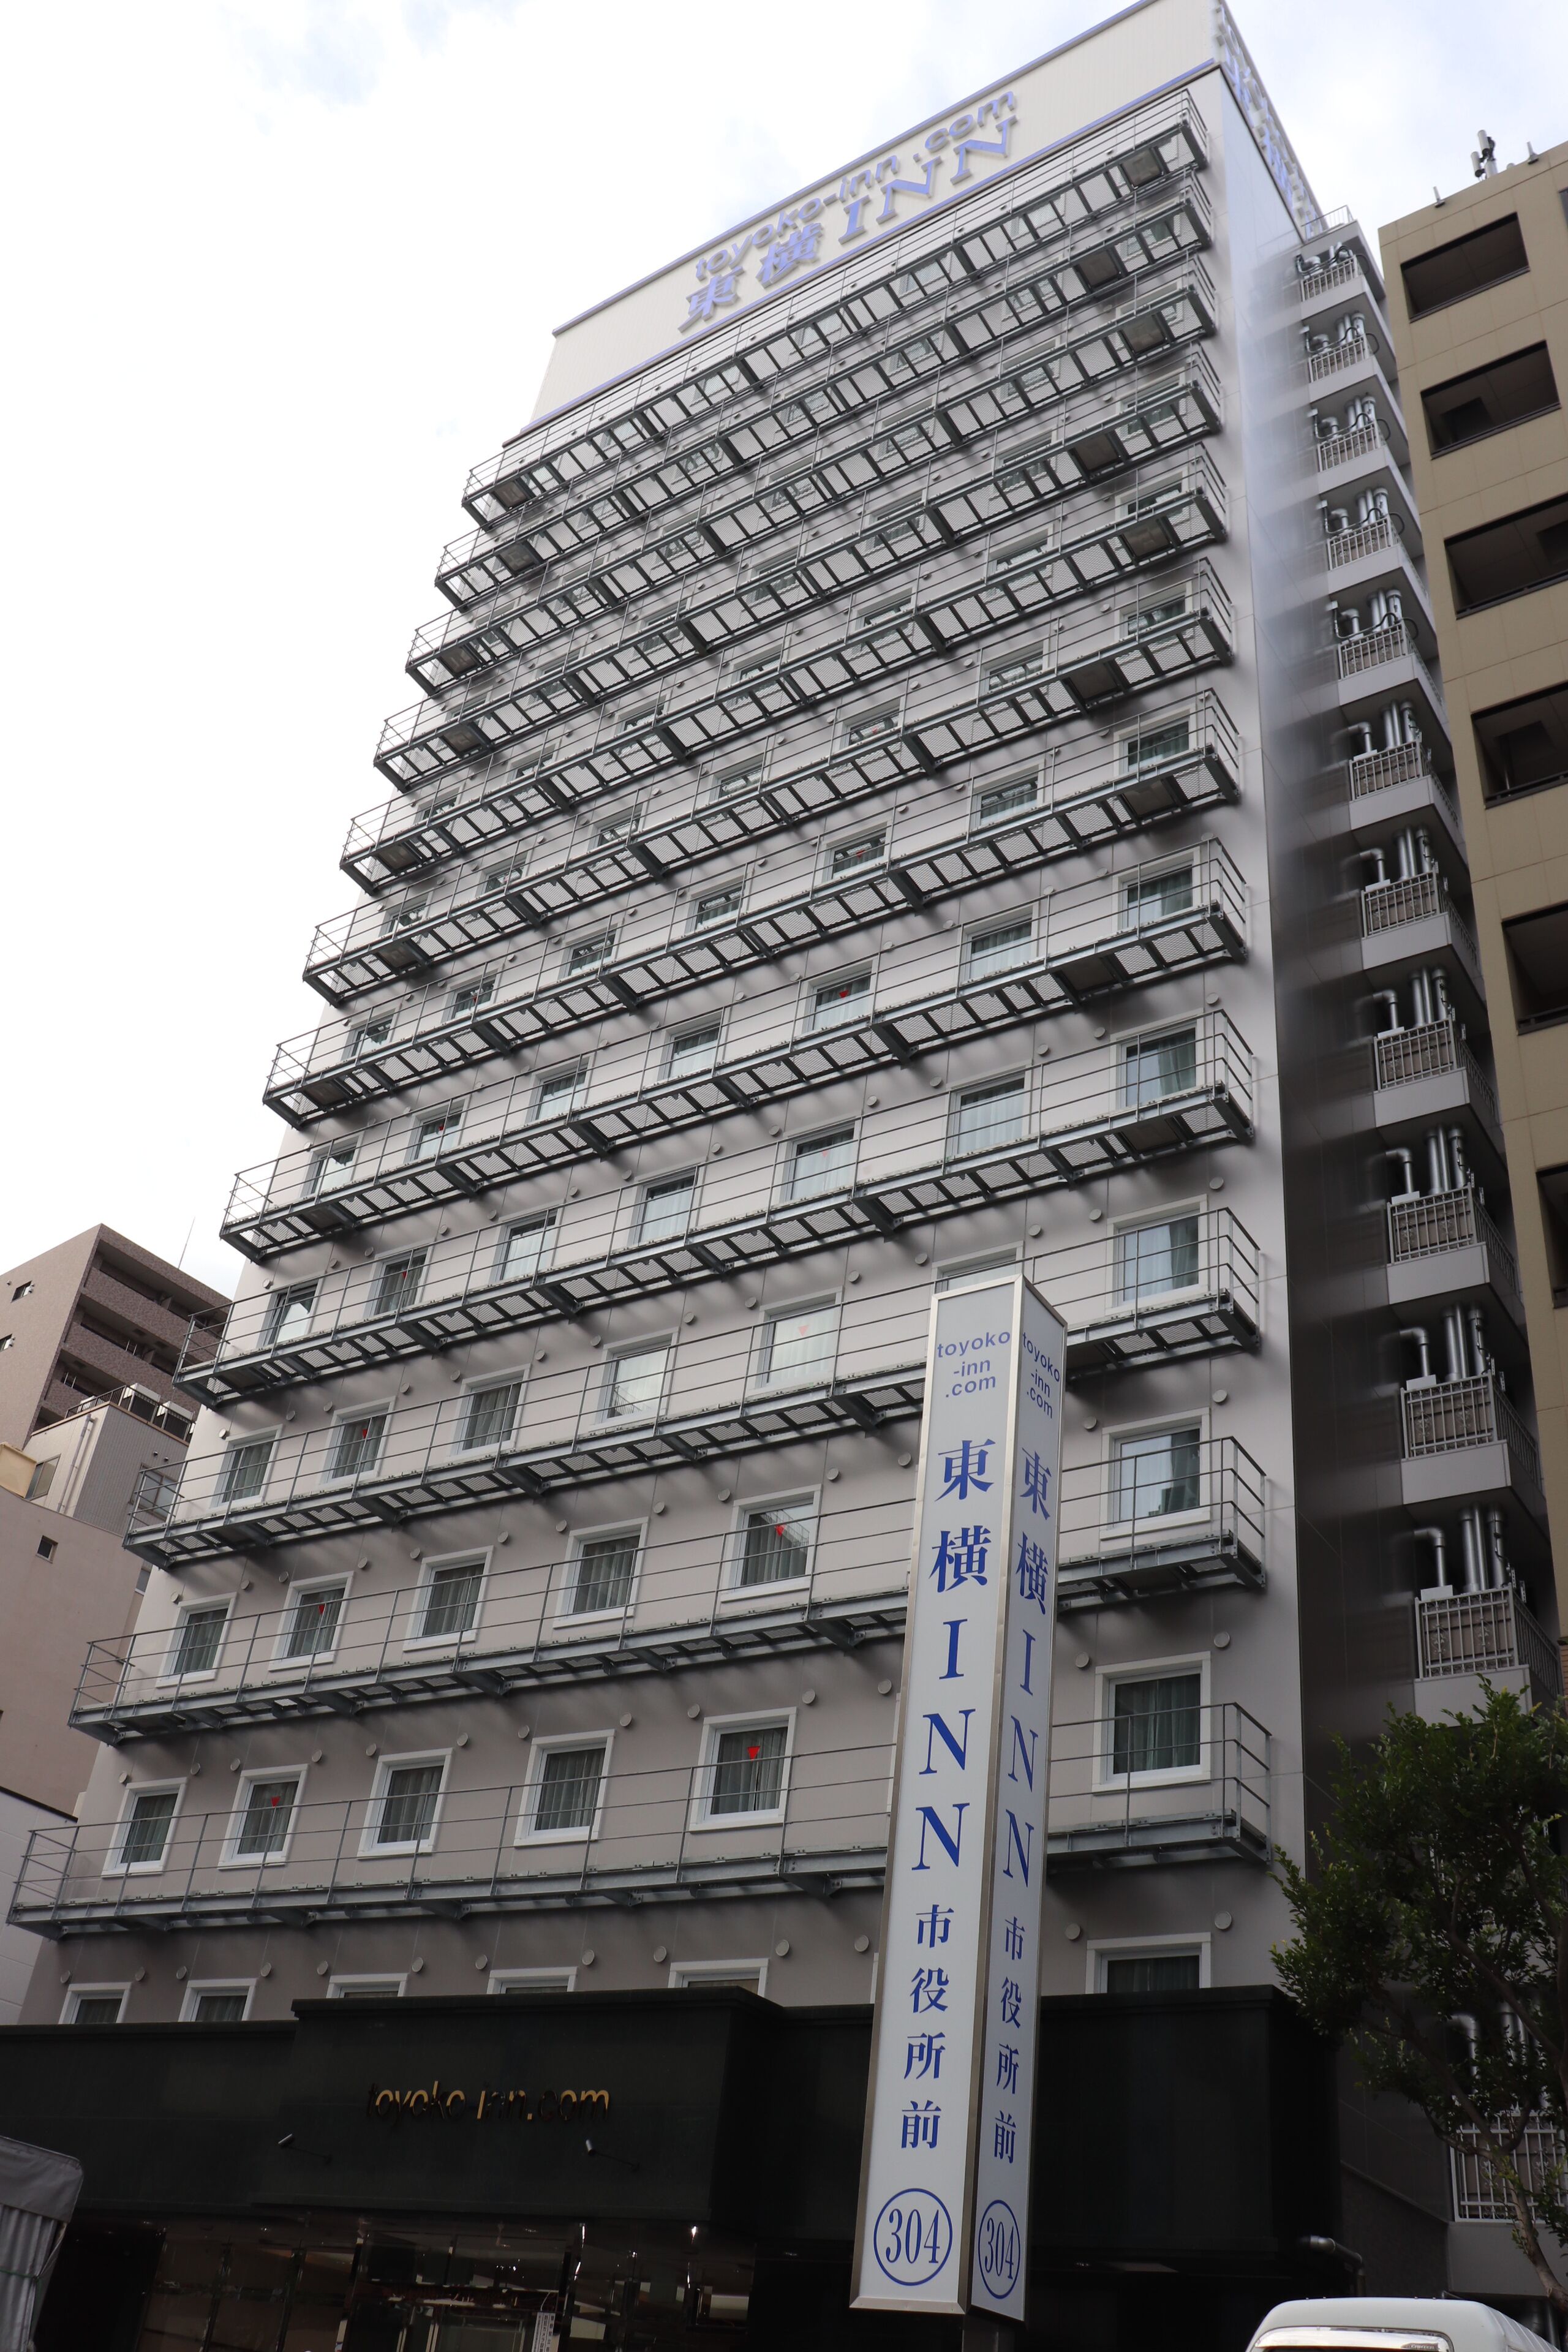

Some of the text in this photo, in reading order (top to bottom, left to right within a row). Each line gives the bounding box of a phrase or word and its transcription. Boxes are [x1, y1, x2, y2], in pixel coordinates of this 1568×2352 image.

[937, 1332, 1011, 1358] toyoko
[1022, 1332, 1060, 1382] toyoko
[953, 1359, 990, 1377] -inn
[945, 1376, 996, 1398] .com
[1031, 1369, 1050, 1398] -inn
[1027, 1387, 1053, 1419] .com
[885, 2207, 941, 2265] 304
[984, 2215, 1015, 2280] 304
